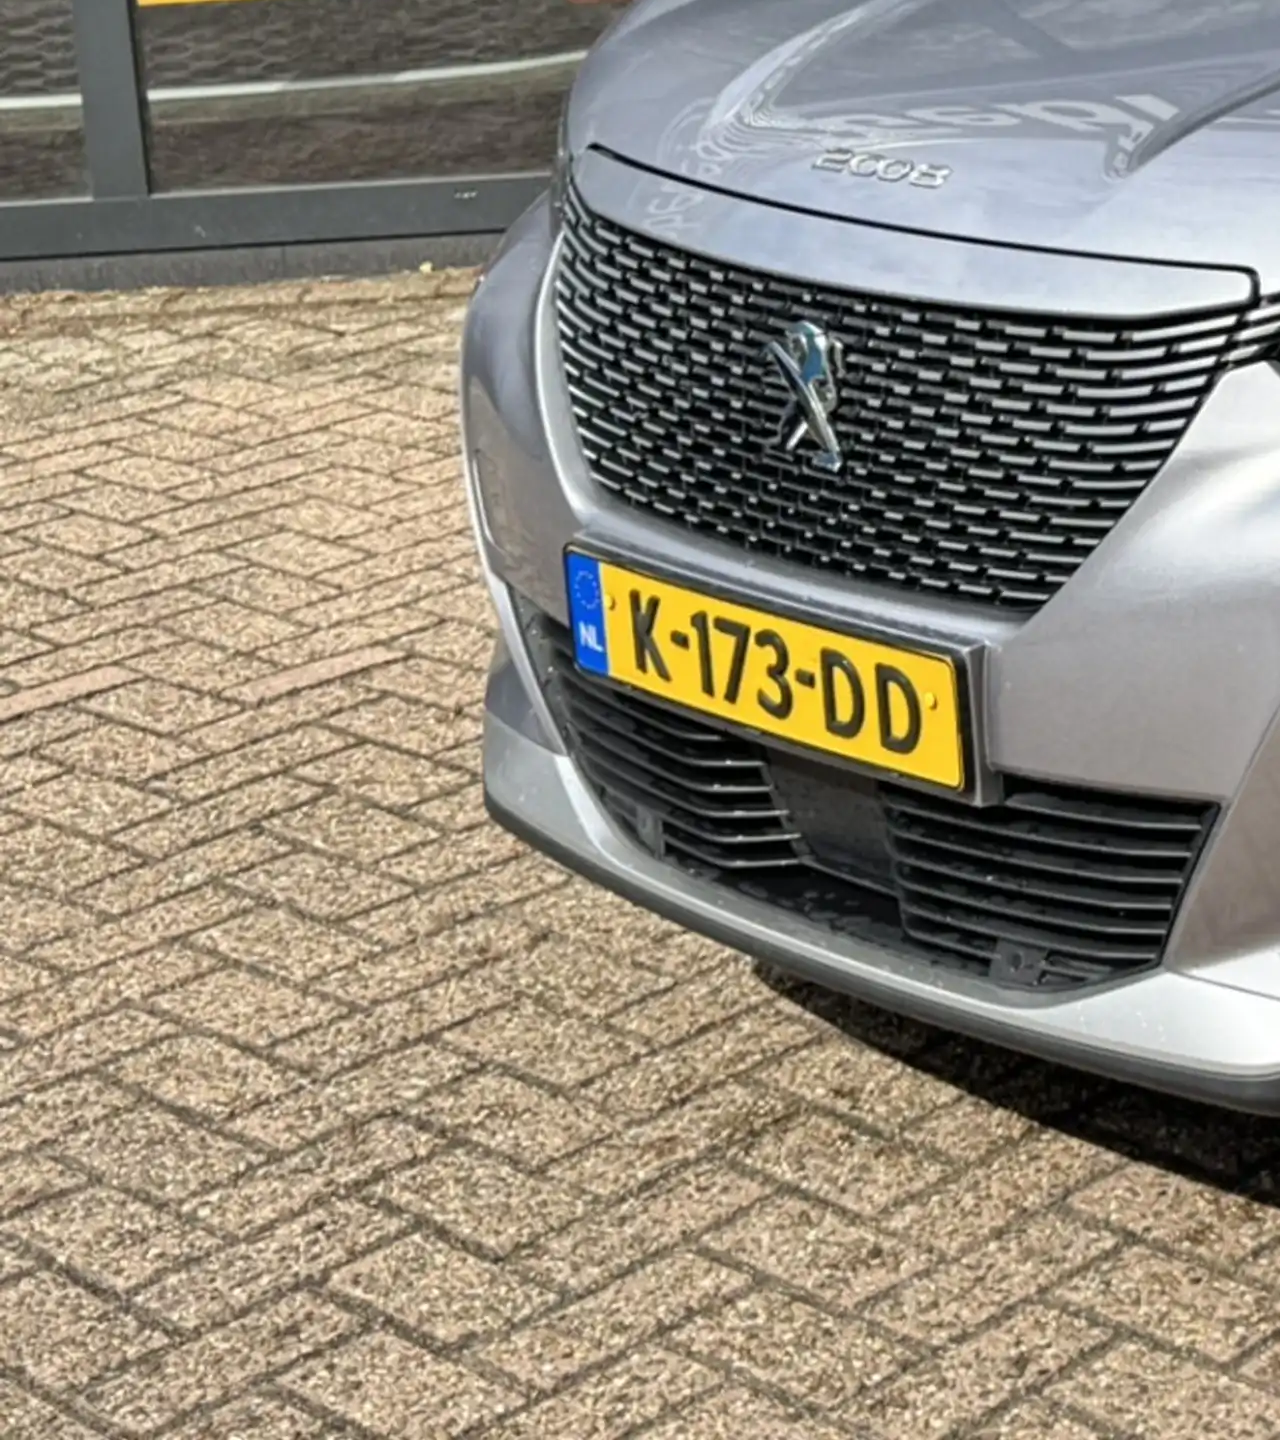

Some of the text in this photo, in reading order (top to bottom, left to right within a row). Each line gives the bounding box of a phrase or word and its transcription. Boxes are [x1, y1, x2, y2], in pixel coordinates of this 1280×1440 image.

[811, 147, 954, 189] 2008
[578, 621, 604, 653] NL
[628, 588, 922, 755] K-173-DD
